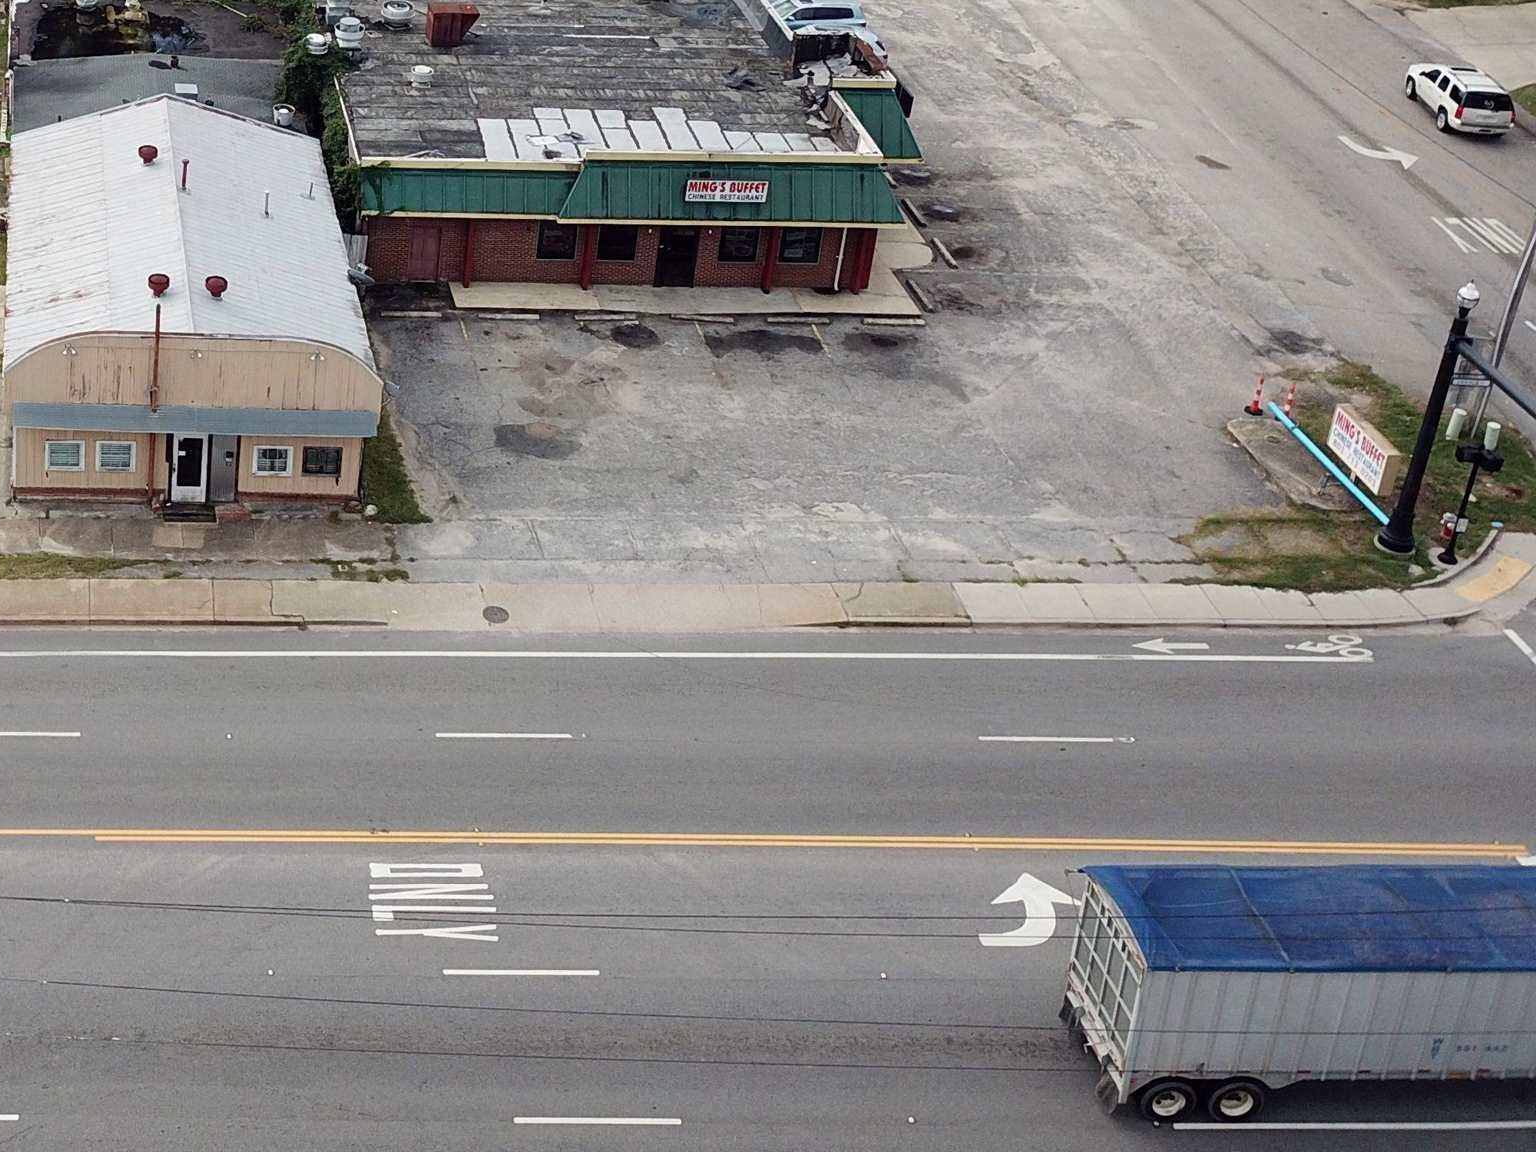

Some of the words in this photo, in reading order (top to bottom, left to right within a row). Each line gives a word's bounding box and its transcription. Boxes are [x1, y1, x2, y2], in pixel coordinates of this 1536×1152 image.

[688, 181, 726, 193] MING'S
[730, 182, 767, 194] BUFFET
[687, 193, 716, 201] CHINESE
[719, 193, 764, 202] RESTAURANT
[368, 862, 499, 943] ONLY
